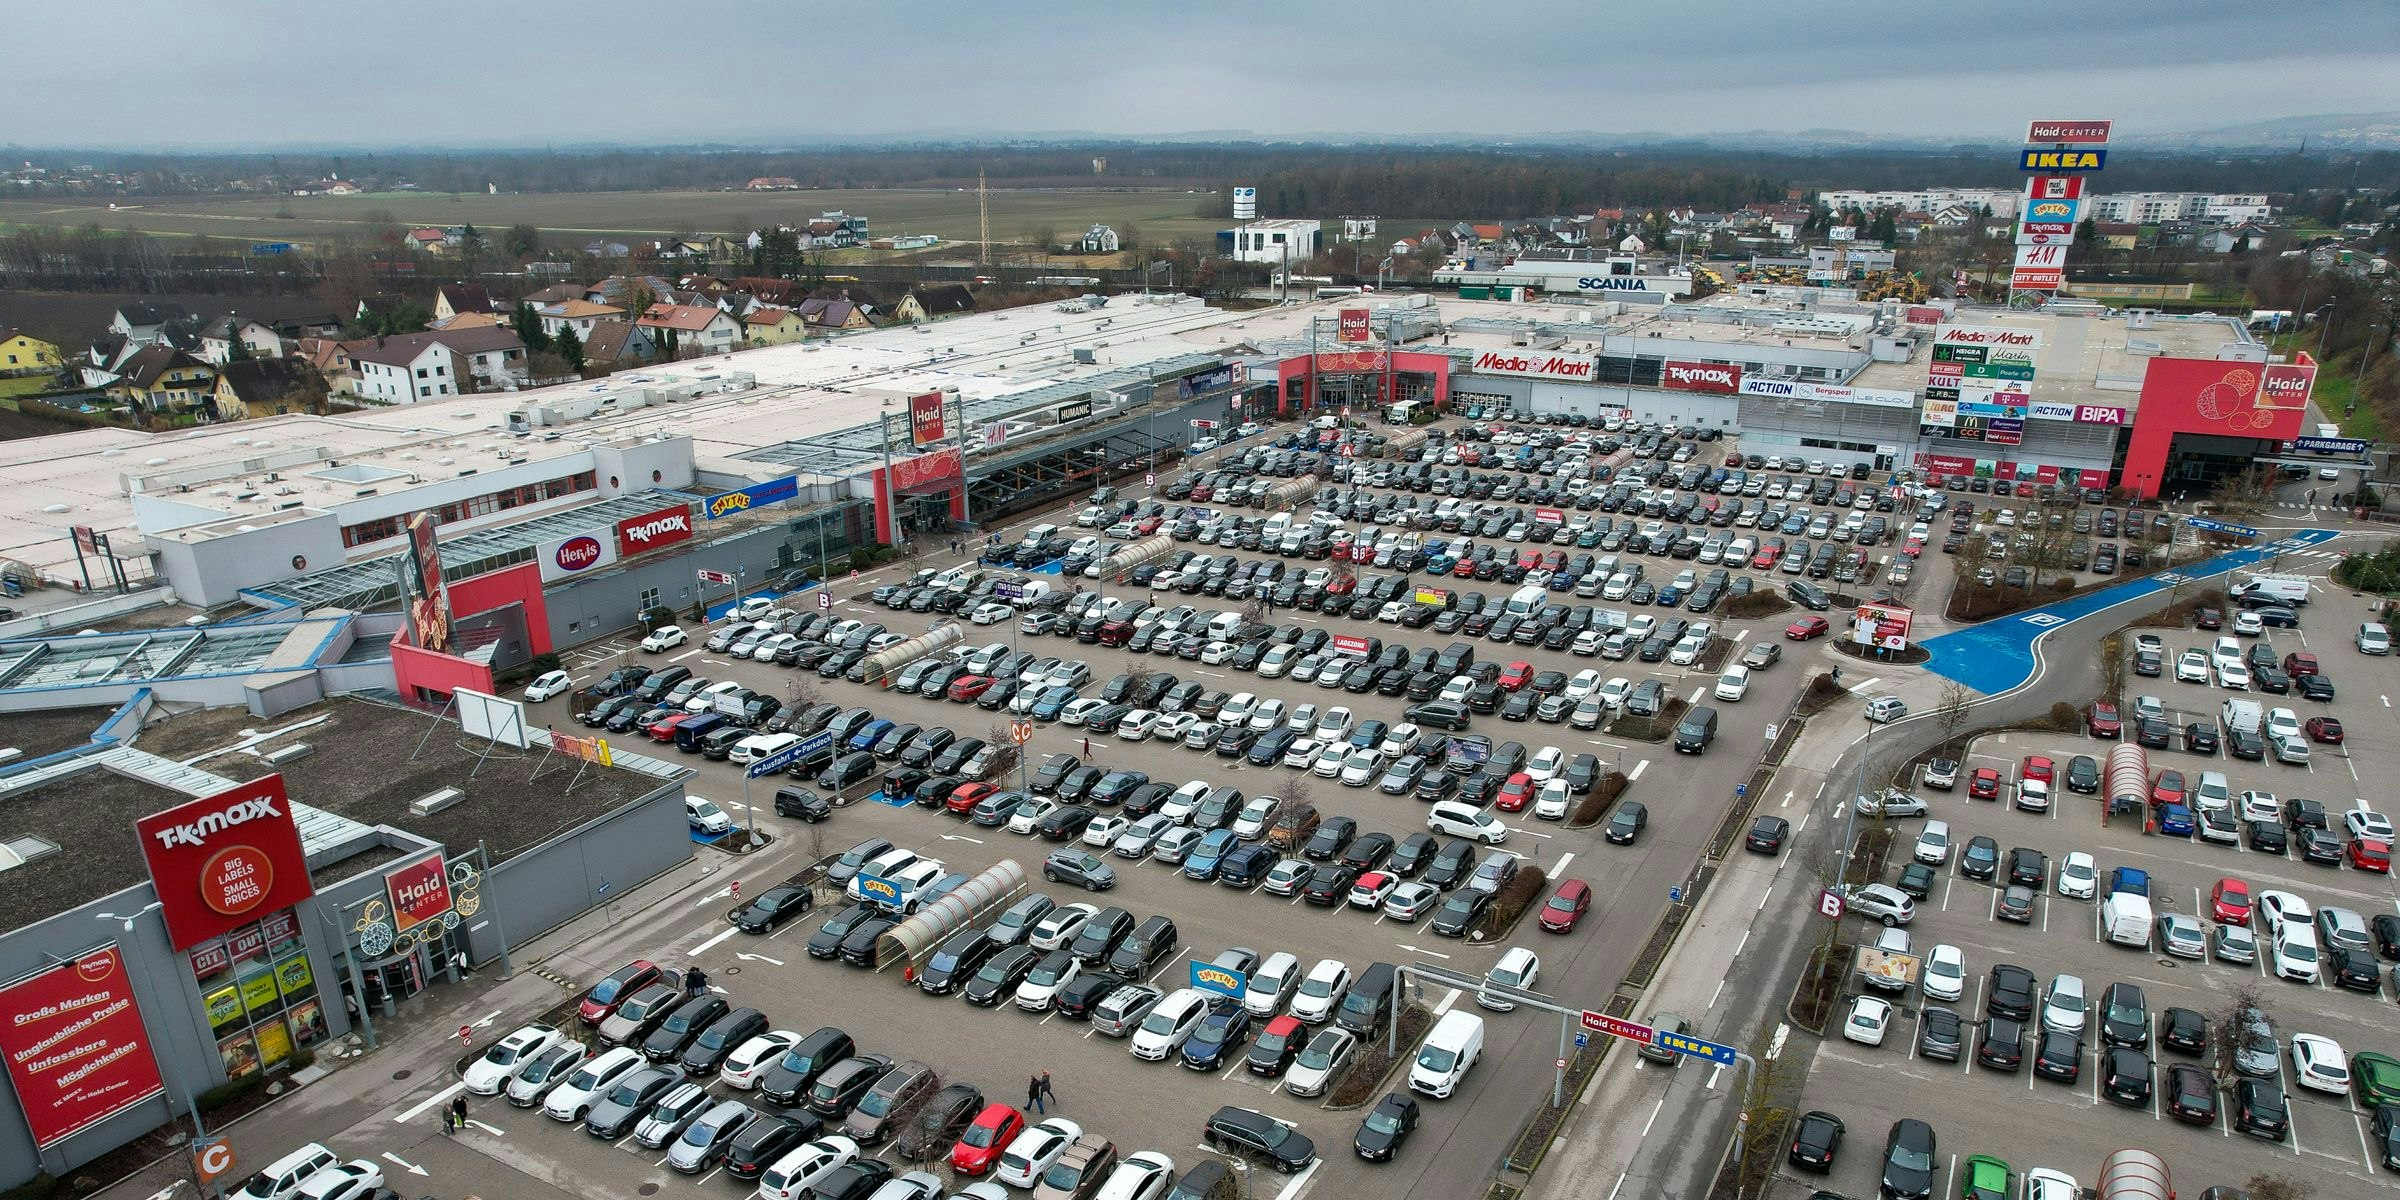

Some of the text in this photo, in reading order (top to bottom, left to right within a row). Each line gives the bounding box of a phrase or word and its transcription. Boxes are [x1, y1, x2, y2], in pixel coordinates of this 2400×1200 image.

[2034, 126, 2105, 136] Haid CENTER
[2026, 153, 2099, 168] IKEA
[2034, 203, 2071, 216] SMYTHS
[2025, 246, 2058, 265] H&M
[1578, 277, 1646, 291] SCANIA
[1343, 318, 1366, 328] Haid
[1943, 329, 2034, 345] Media Markt
[1474, 353, 1591, 376] Media Markt
[1748, 381, 1793, 395] ACTION
[1928, 376, 1961, 388] KULT
[2008, 381, 2022, 389] dm
[2268, 377, 2306, 391] Haid
[916, 406, 940, 424] Haid
[1061, 404, 1089, 420] HUMANIC
[1342, 408, 1350, 416] A
[2035, 407, 2073, 416] ACTION
[2081, 407, 2119, 423] BIPA
[917, 422, 940, 432] CENTER
[1960, 428, 1980, 437] CCC
[1342, 448, 1352, 456] A
[1457, 448, 1464, 456] A
[2304, 440, 2357, 450] PARKGARAGE
[1146, 475, 1154, 485] B
[711, 493, 750, 516] SMYTHS
[560, 544, 598, 564] Hervis
[819, 594, 829, 607] B
[1337, 639, 1365, 649] LADEZONE
[1012, 723, 1030, 740] C C
[802, 735, 831, 753] Parkdeck
[762, 754, 790, 772] Ausfahrt
[224, 858, 242, 872] BIG
[218, 864, 254, 885] LABELS
[223, 878, 256, 896] SMALL
[398, 873, 441, 904] Haid
[864, 880, 896, 897] SMYTHS
[224, 886, 260, 907] PRICES
[402, 891, 444, 914] CENTER
[1822, 893, 1840, 916] B
[196, 919, 291, 969] CITY OUTLET
[1197, 969, 1238, 989] SMYTHS
[14, 991, 110, 1024] Große Marken
[14, 998, 129, 1062] Unglaubliche Preise
[1586, 1016, 1648, 1039] Haid CENTER
[1576, 1035, 1585, 1043] P1
[1664, 1036, 1714, 1056] IKEA
[27, 1039, 107, 1072] Unfassbare
[56, 1041, 137, 1087] Möglichkeiten
[77, 1079, 129, 1102] im Haid Center
[53, 1099, 63, 1108] TK
[203, 1145, 230, 1174] C
